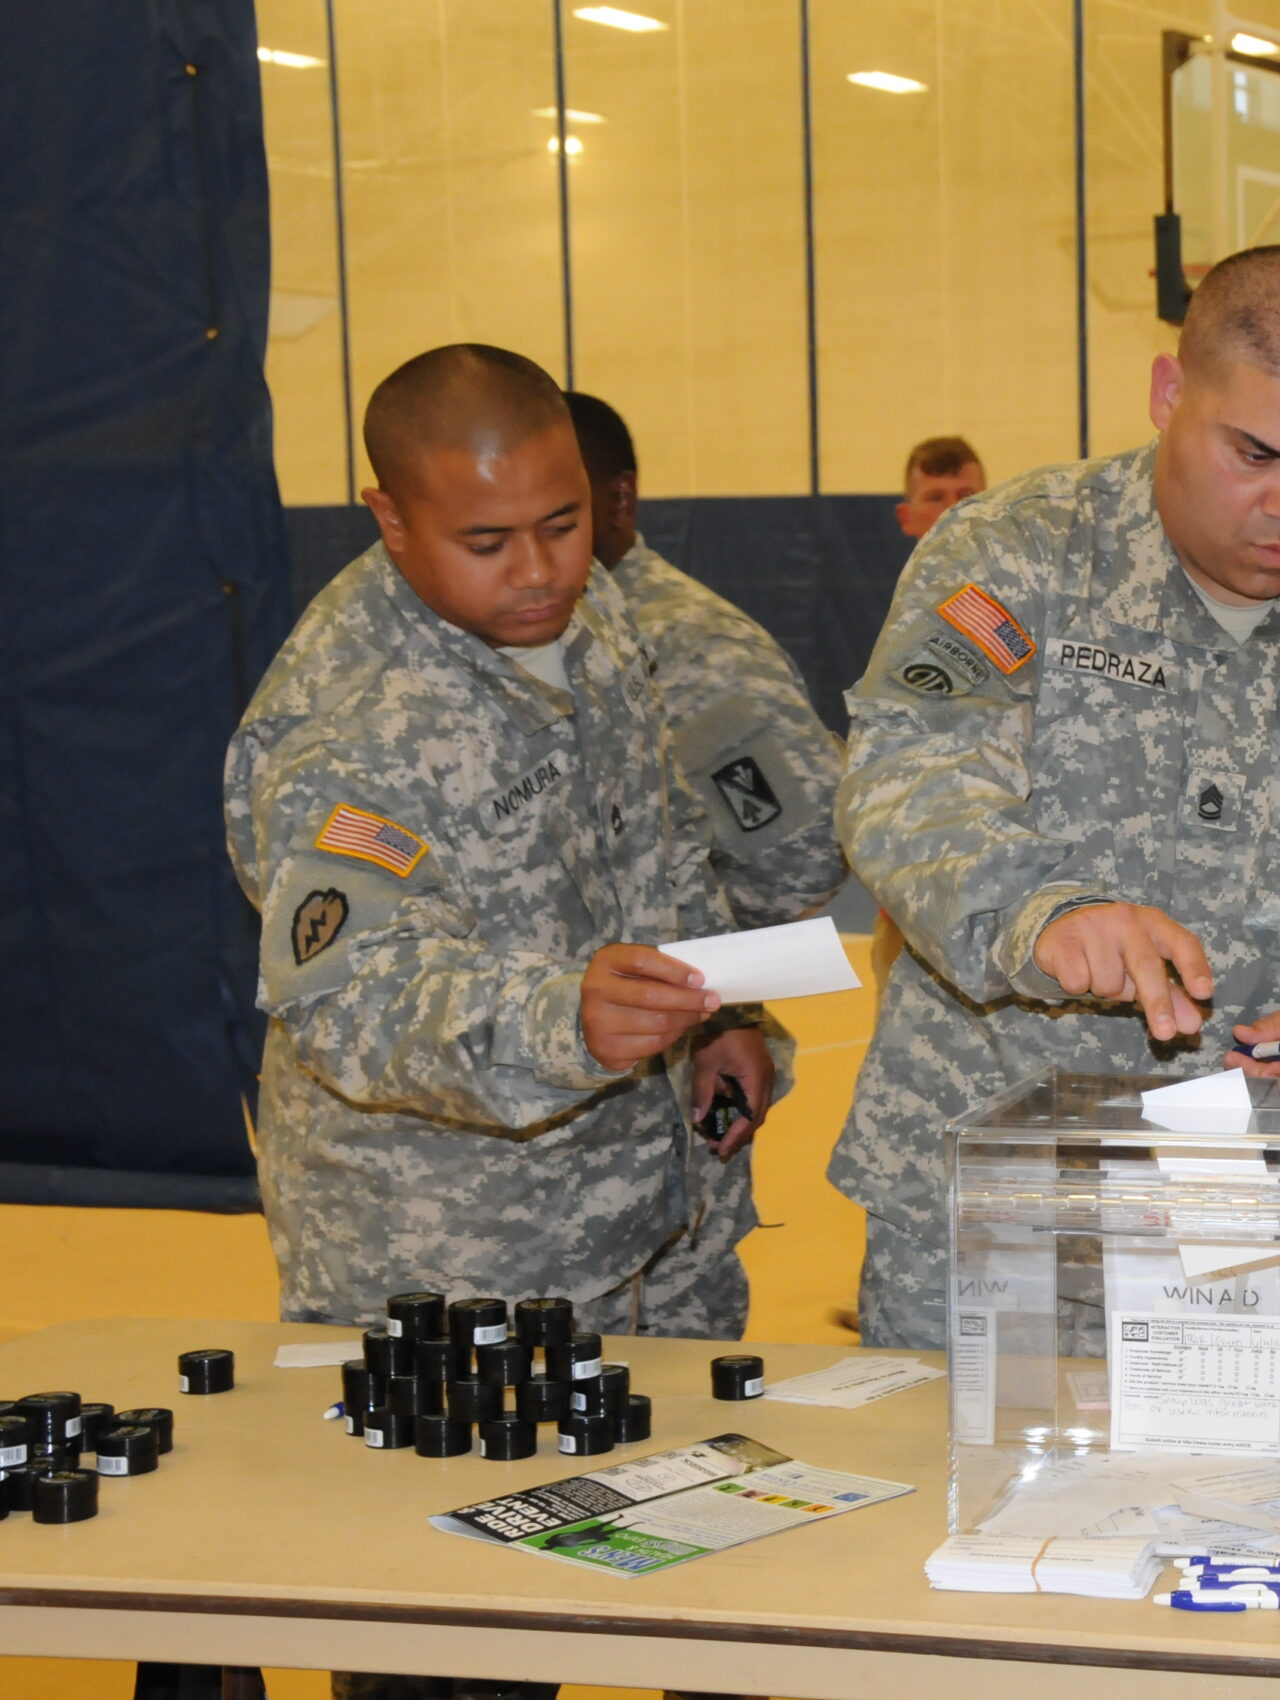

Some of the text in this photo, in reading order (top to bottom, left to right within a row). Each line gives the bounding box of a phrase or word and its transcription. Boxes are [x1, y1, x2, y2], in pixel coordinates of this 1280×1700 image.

[929, 637, 985, 679] AIRBORNE
[1060, 644, 1166, 688] PEDRAZA
[493, 761, 562, 820] NOMURA
[1162, 1286, 1213, 1305] WIN
[1218, 1288, 1237, 1307] A
[474, 1513, 525, 1538] RIDE
[475, 1501, 545, 1533] DRIVE
[494, 1497, 562, 1527] EVENT
